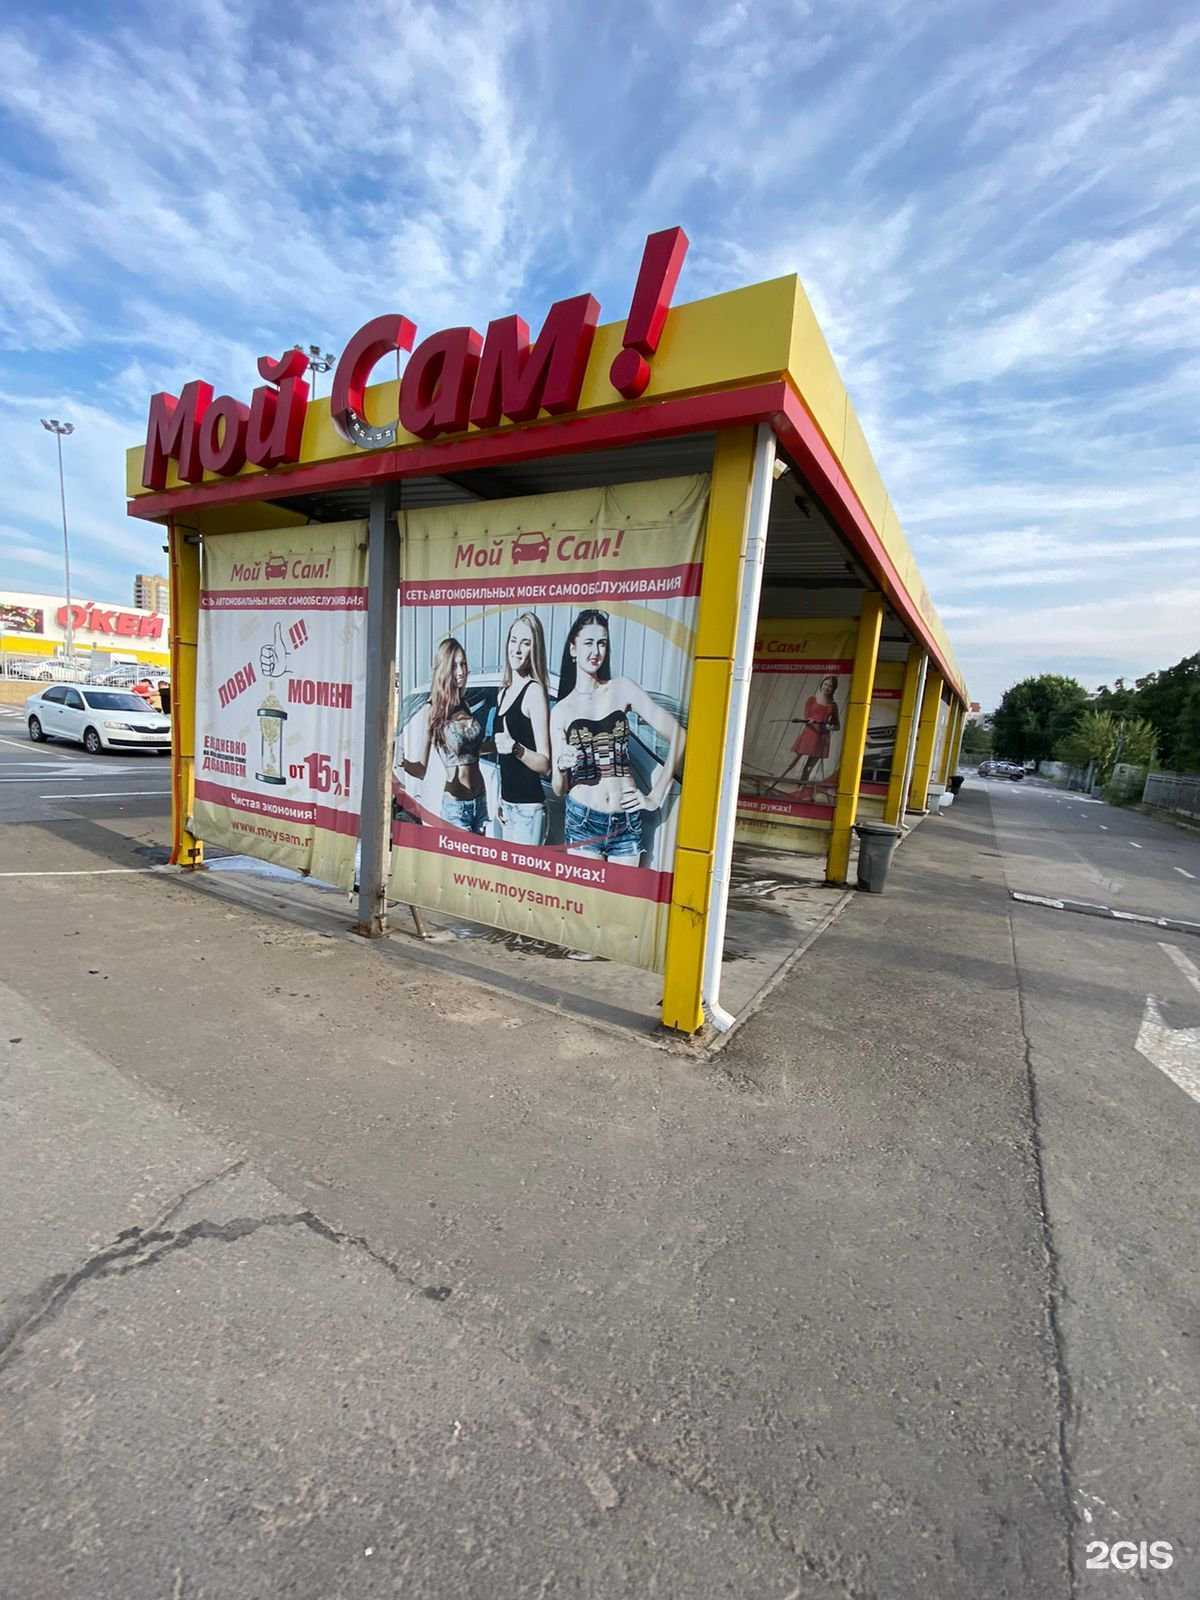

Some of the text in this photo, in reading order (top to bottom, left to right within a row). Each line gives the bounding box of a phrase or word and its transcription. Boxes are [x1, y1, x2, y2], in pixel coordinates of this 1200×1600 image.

[142, 349, 310, 490] Мой
[454, 530, 625, 569] Мой Сам!
[230, 558, 332, 582] Мой Сам!
[406, 576, 682, 601] СЕТЬ АВТОМОБИЛЬНЫХ МОЕК САМООБСЛУЖИВАНИЯ
[217, 662, 257, 709] ЛОВИ
[262, 802, 317, 820] экономия!
[231, 820, 315, 847] www.moysam.r
[438, 835, 606, 883] Качество в твоих руках!
[453, 872, 584, 915] www.moysam.ru
